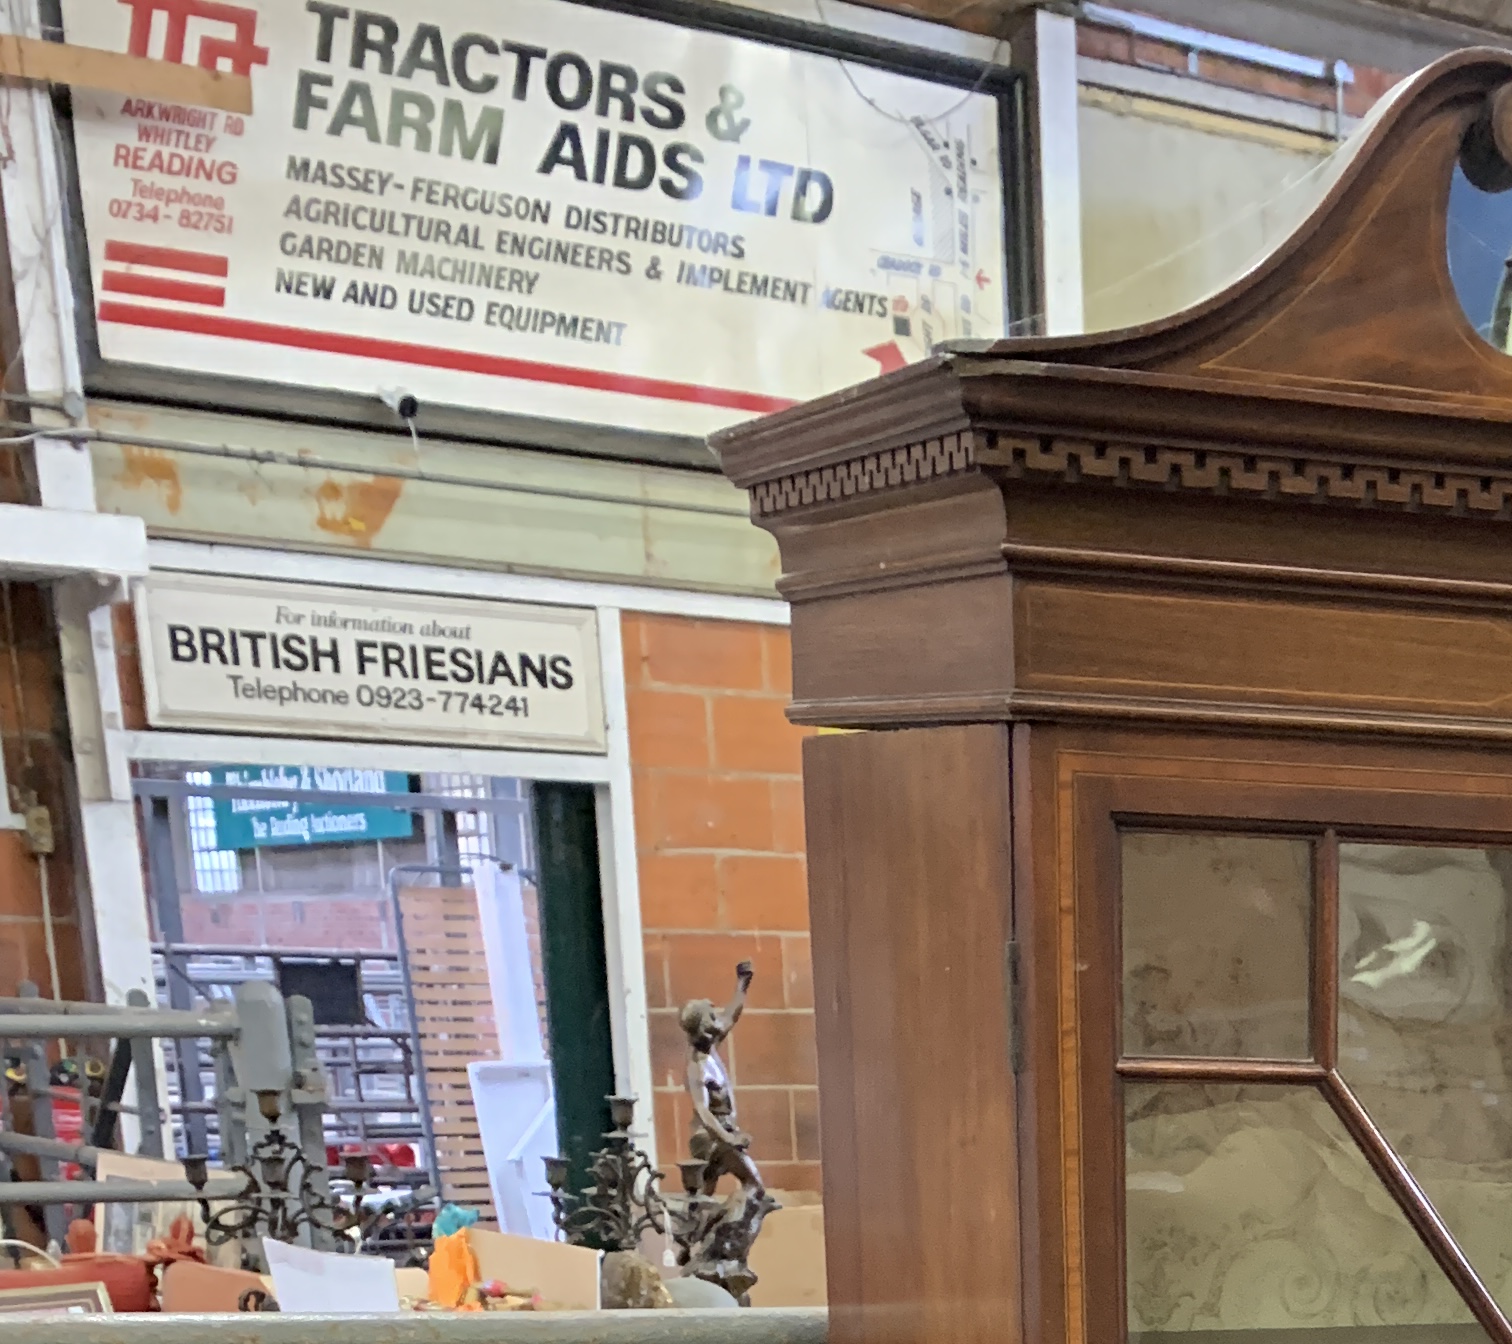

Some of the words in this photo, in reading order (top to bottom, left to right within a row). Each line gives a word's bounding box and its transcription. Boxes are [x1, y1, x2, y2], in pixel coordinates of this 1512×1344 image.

[305, 0, 686, 130] TRACTORS
[705, 83, 750, 143] &
[120, 96, 218, 131] ARKWRIGHT
[223, 114, 245, 136] RD
[137, 123, 217, 154] WHITLEY
[113, 143, 239, 185] READING
[292, 68, 505, 165] FARM
[536, 120, 704, 200] AIDS
[731, 154, 834, 224] LTD
[108, 198, 159, 225] 0734
[177, 209, 234, 235] 82751
[131, 177, 226, 211] Telephone
[565, 204, 746, 258] DISTRIBUTORS
[280, 231, 385, 271] GARDEN
[395, 248, 540, 295] MACHINERY
[282, 194, 485, 250] AGRICULTURAL
[496, 229, 632, 275] ENGINEERS
[645, 256, 663, 280] &
[677, 260, 812, 306] IMPLEMENT
[820, 286, 889, 318] AGENTS
[275, 267, 336, 300] NEW
[342, 279, 398, 310] AND
[407, 288, 475, 322] USED
[485, 301, 628, 346] EQUIPMENT
[275, 605, 306, 625] For
[310, 610, 414, 634] information
[419, 619, 472, 640] about
[167, 623, 341, 674] BRITISH
[354, 639, 574, 690] FRIESIANS
[226, 674, 349, 707] Telephone
[356, 684, 529, 717] 0923-774241
